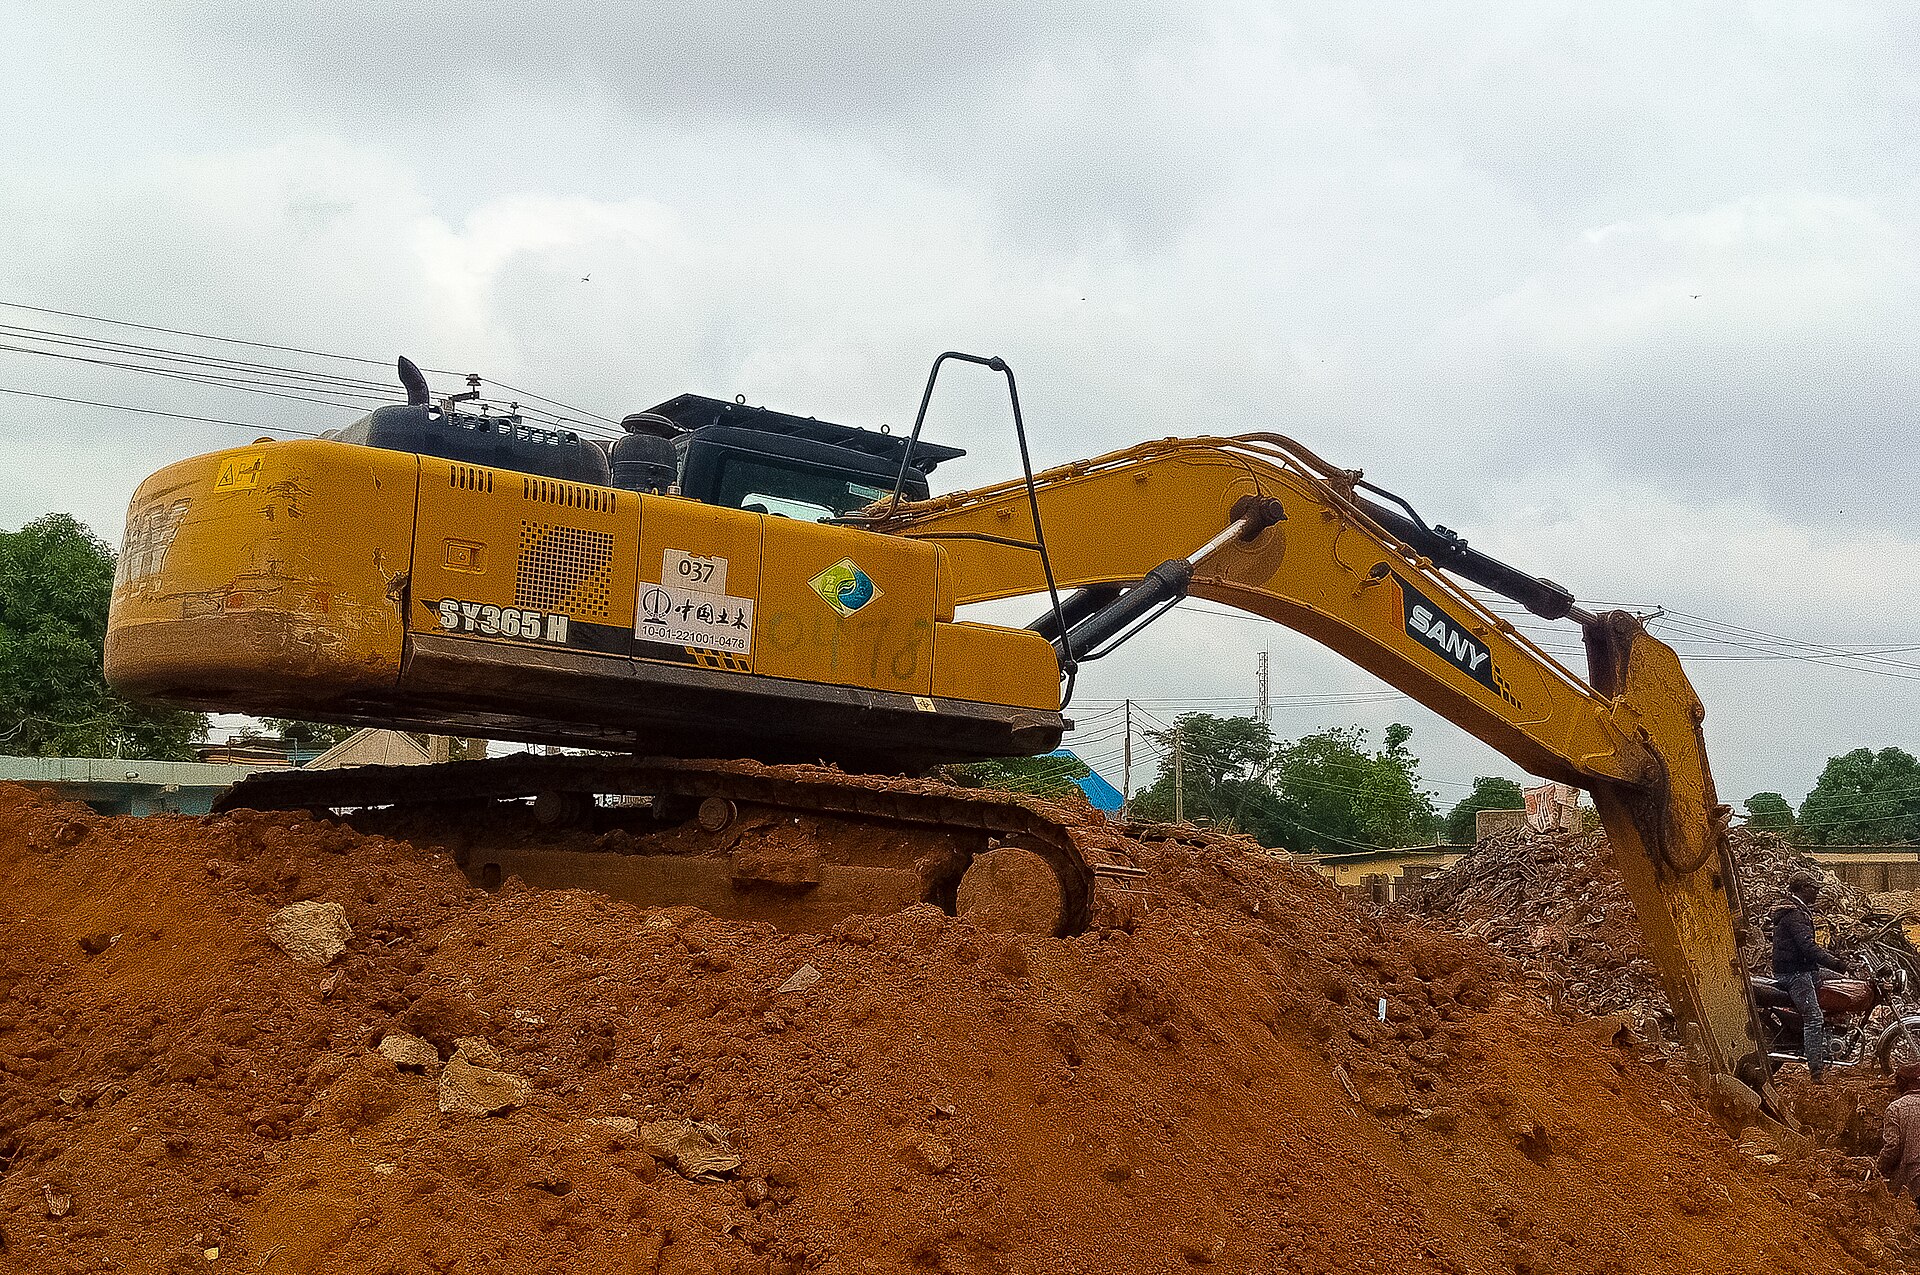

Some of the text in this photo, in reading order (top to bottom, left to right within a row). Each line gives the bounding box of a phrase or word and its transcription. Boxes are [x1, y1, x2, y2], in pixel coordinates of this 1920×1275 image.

[678, 559, 714, 583] 037
[674, 597, 749, 630] 中国土木
[642, 625, 745, 649] 10-01-221001-0478
[1409, 604, 1488, 671] SANY
